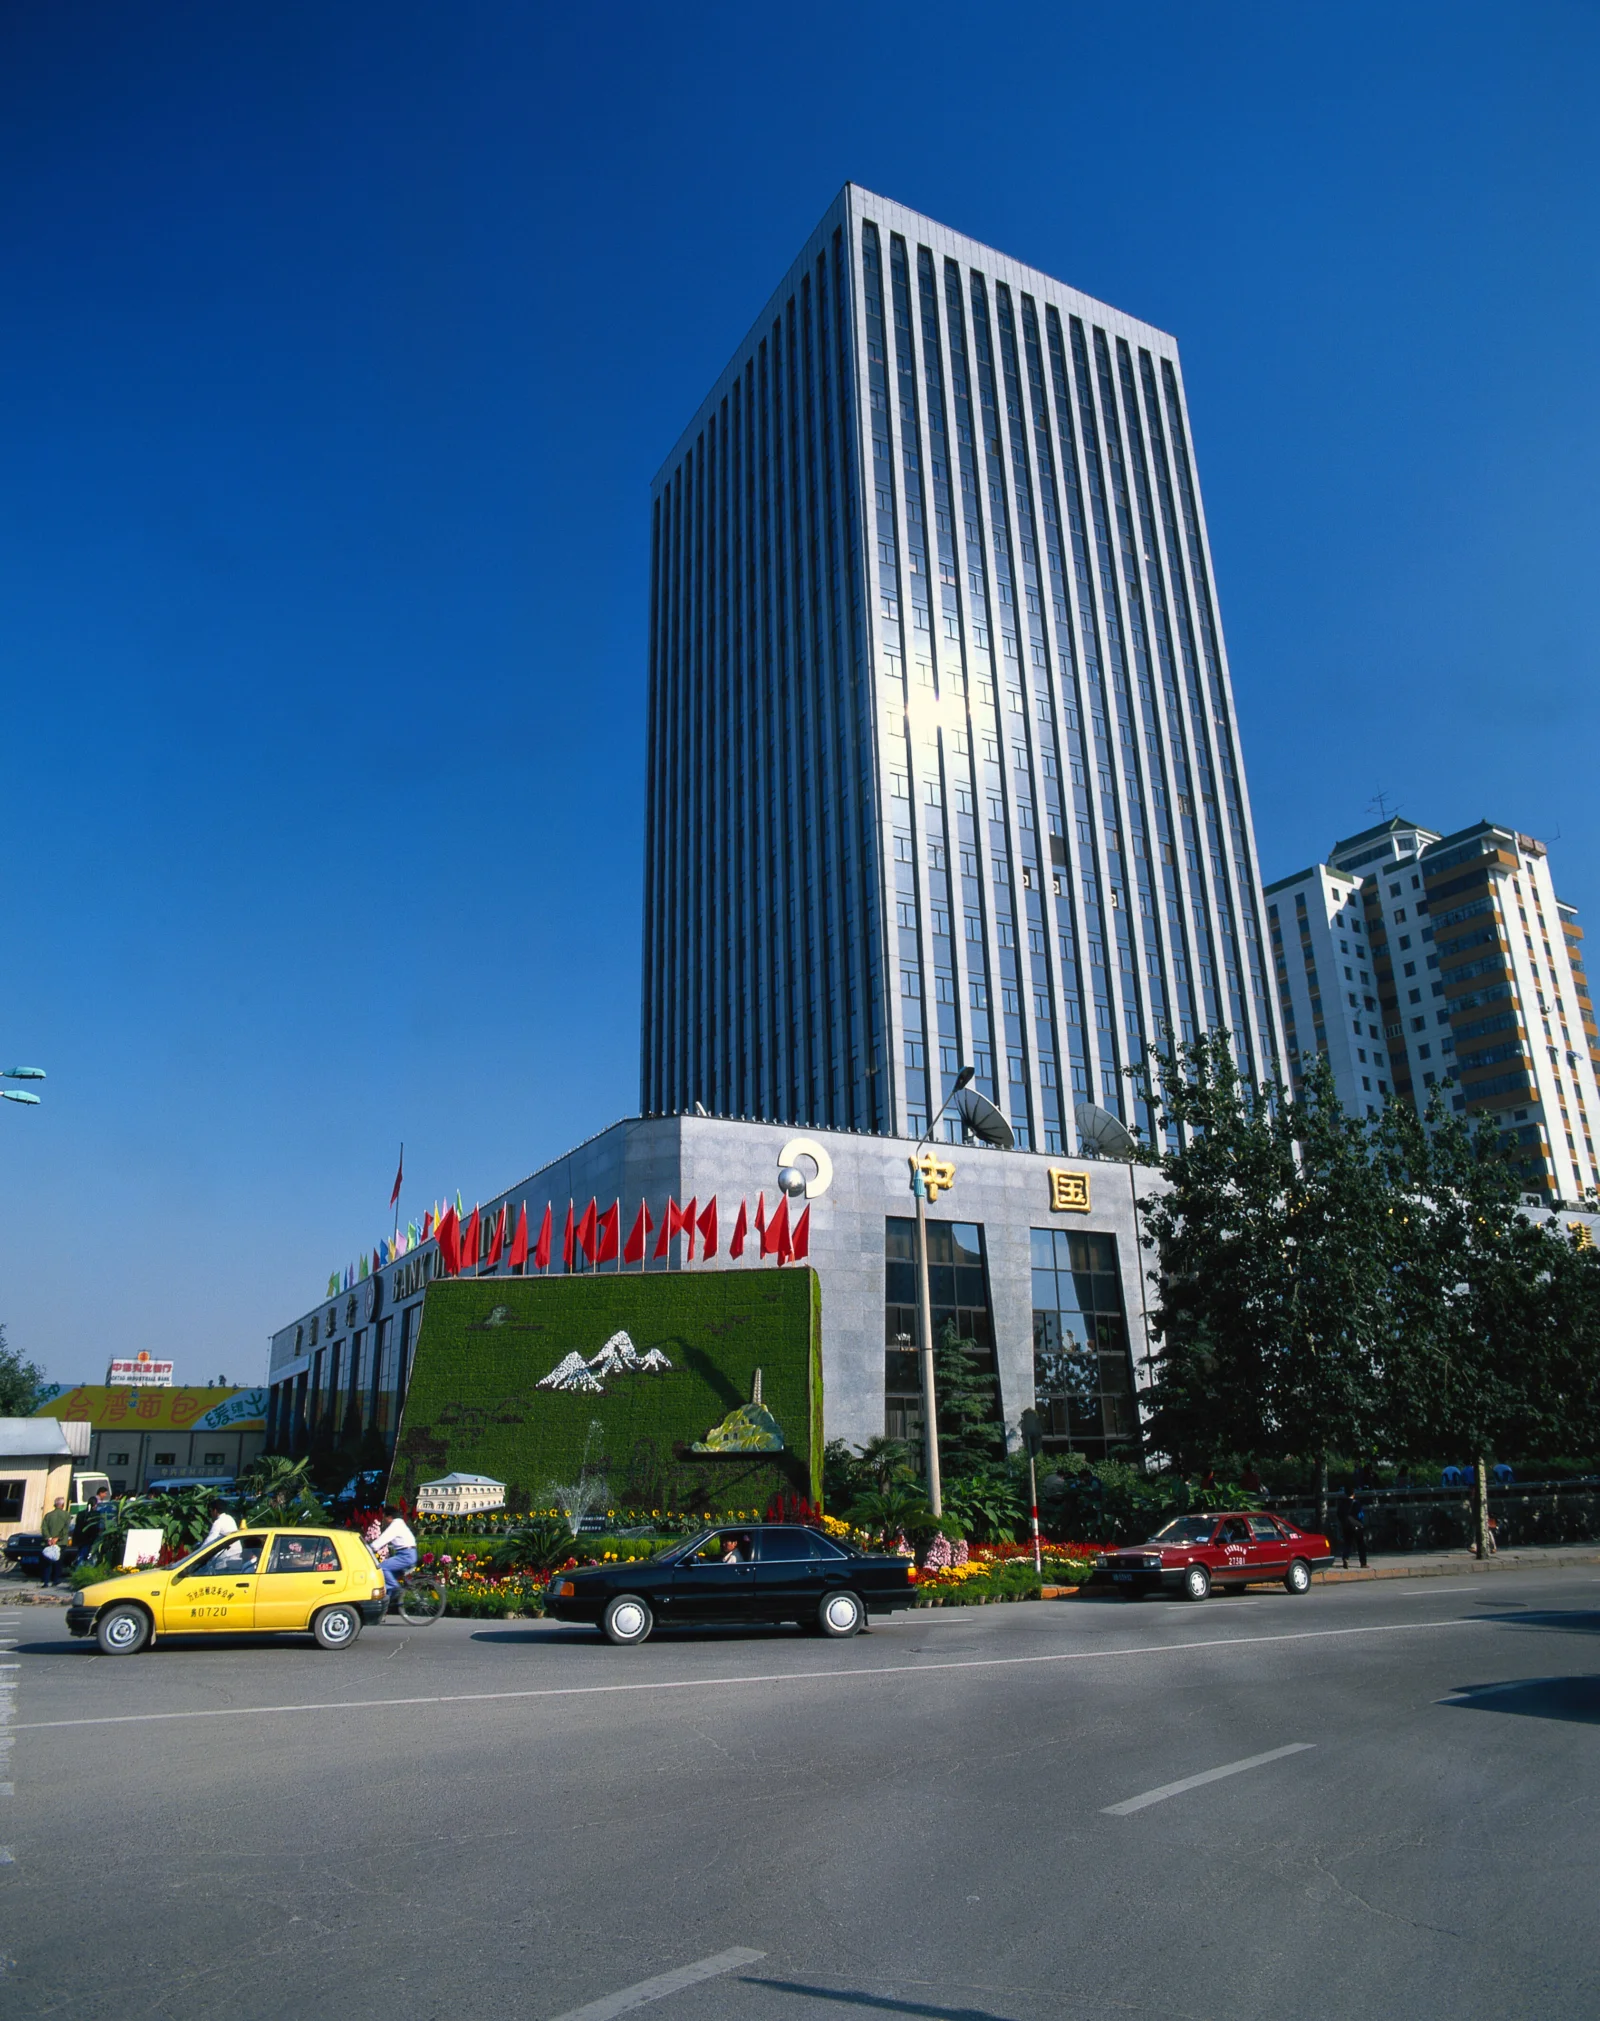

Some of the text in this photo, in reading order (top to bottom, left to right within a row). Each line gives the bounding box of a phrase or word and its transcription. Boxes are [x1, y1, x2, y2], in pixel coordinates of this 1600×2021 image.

[392, 1251, 428, 1302] BANK
[64, 1388, 217, 1424] 台湾面包
